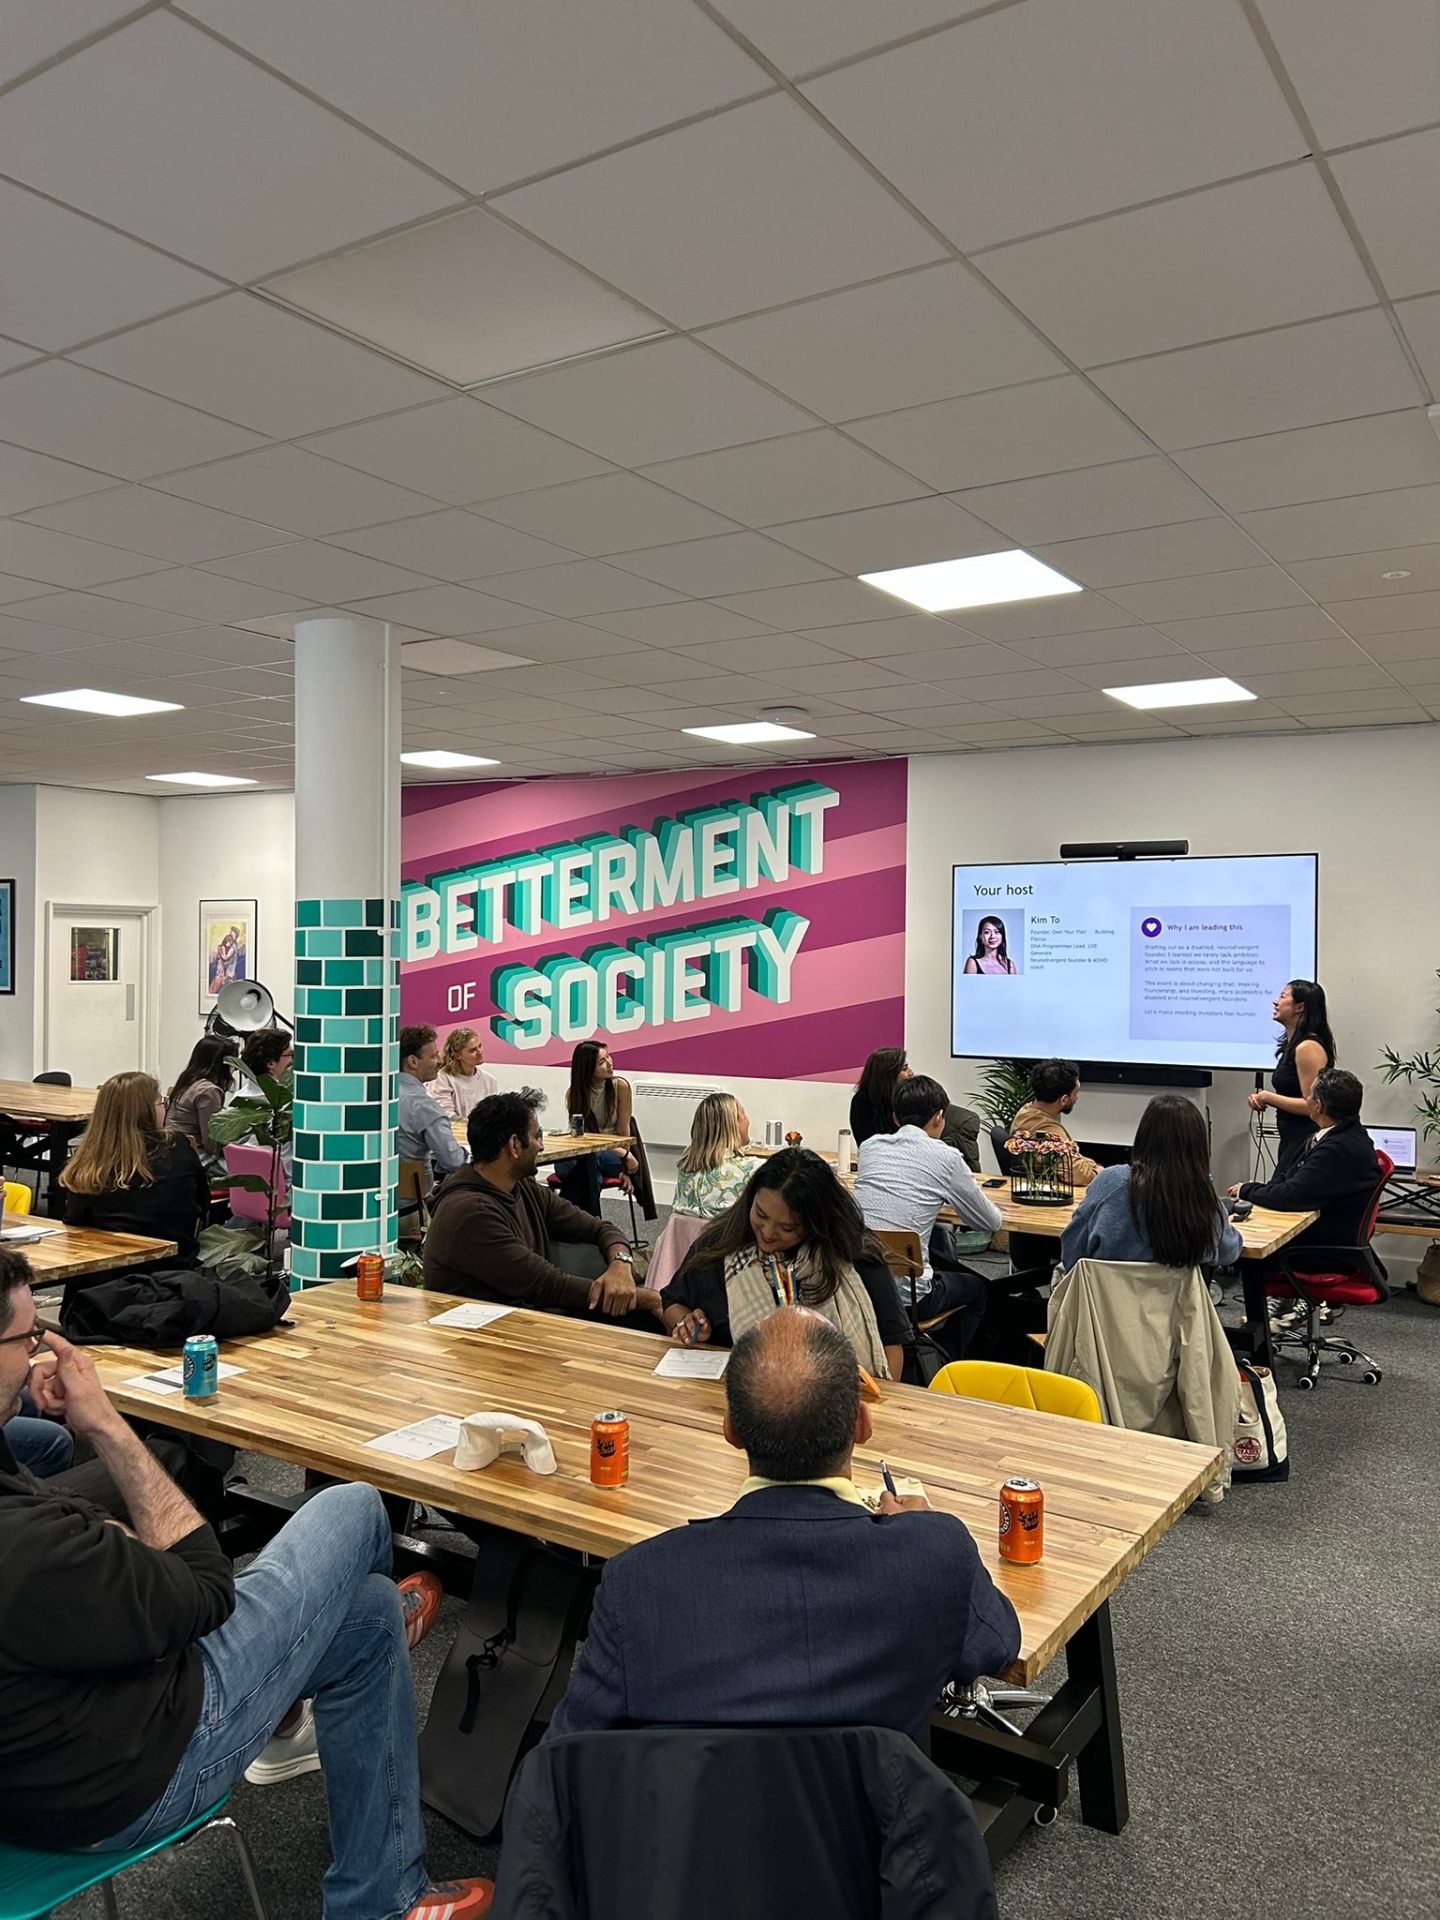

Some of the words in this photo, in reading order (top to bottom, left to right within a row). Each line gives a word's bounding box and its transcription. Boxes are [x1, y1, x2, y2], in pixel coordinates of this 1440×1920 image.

[399, 780, 840, 962] BETTERMENT
[974, 885, 1002, 896] Your
[1006, 884, 1034, 896] host
[1031, 916, 1047, 924] Kim
[1050, 916, 1061, 924] To
[1167, 924, 1183, 932] Why
[1201, 924, 1228, 932] leading
[1229, 924, 1243, 932] this
[447, 981, 477, 1012] OF
[492, 908, 811, 1050] SOCIETY
